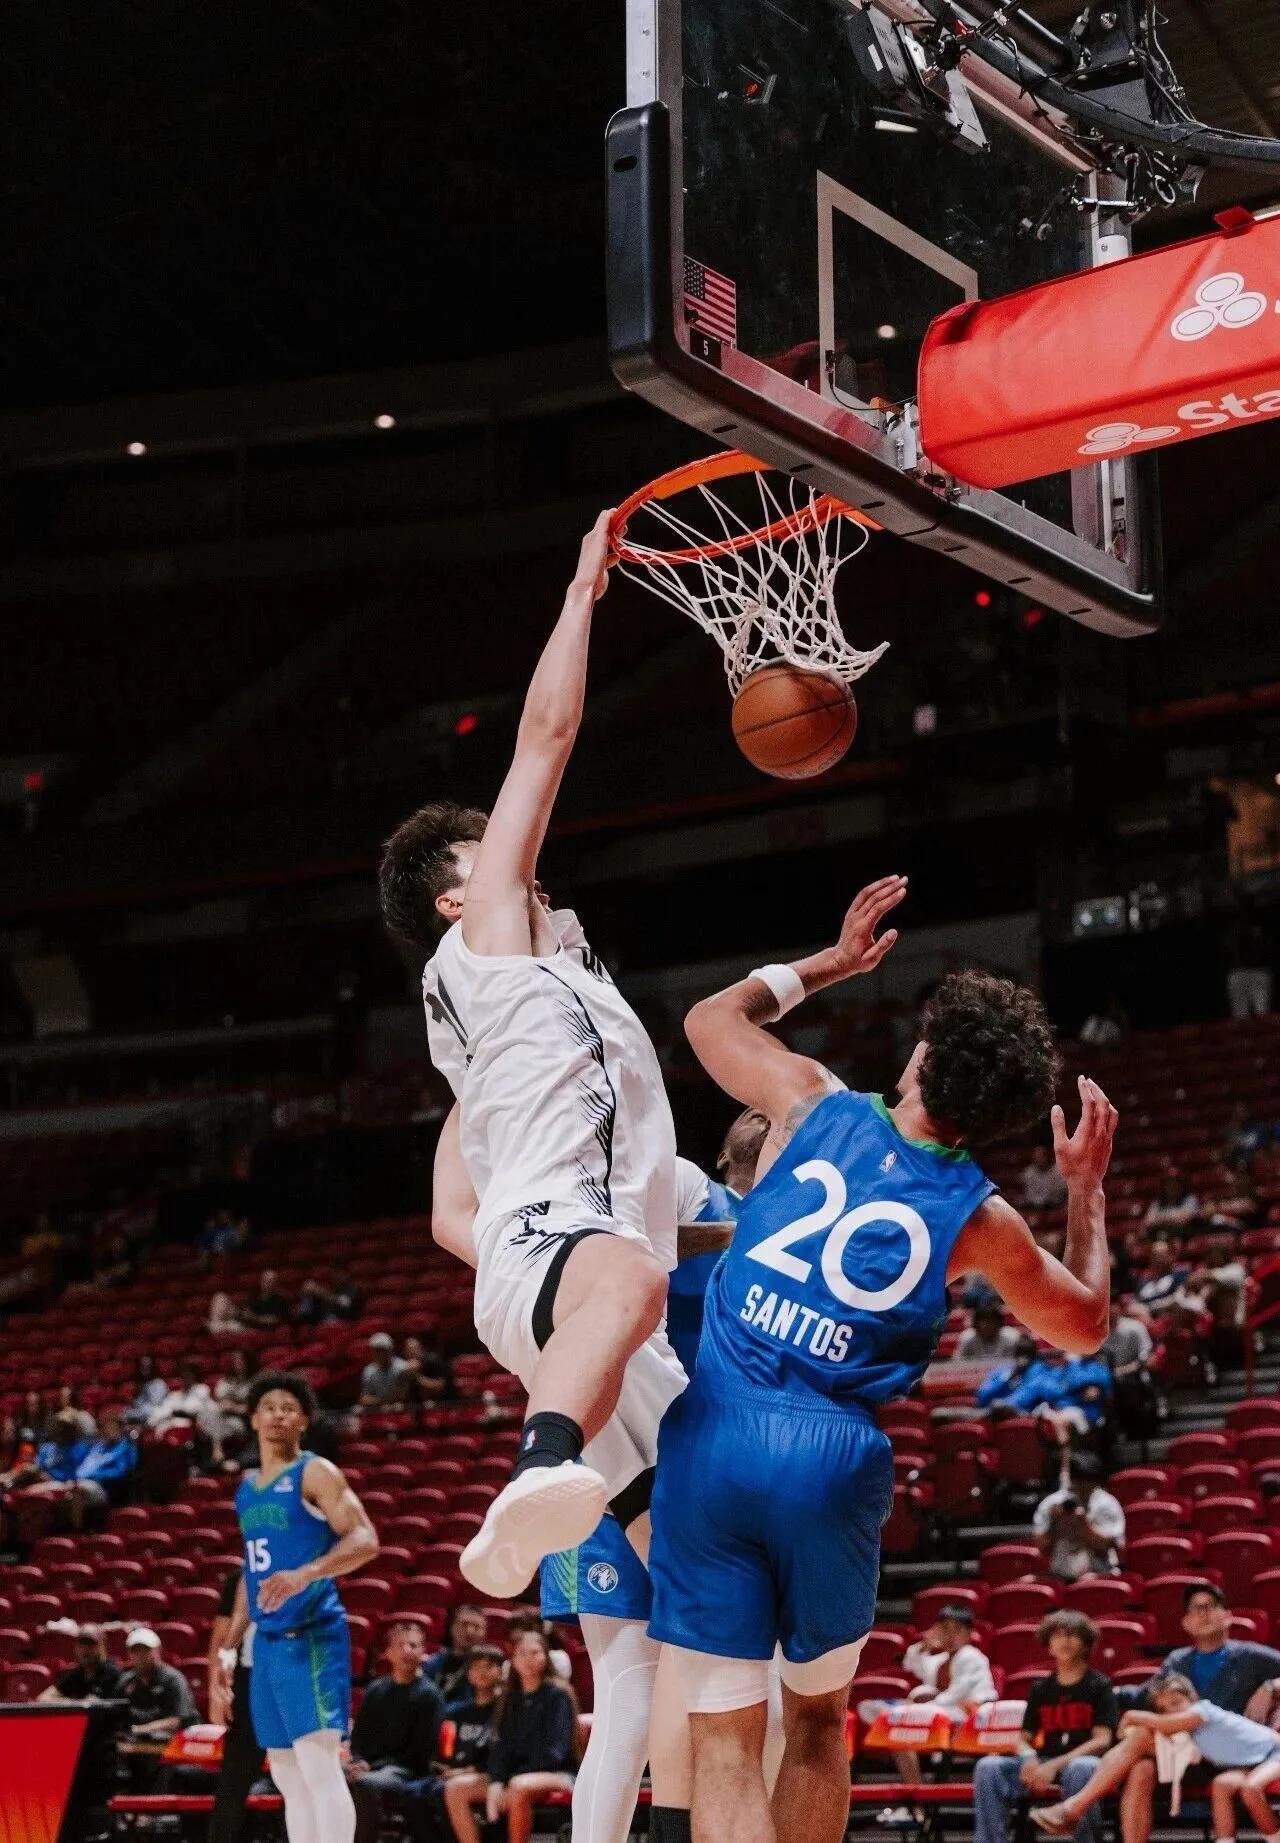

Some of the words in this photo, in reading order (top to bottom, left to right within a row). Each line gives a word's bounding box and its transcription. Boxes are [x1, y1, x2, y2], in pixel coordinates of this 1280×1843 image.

[703, 340, 709, 356] 5
[745, 1159, 931, 1312] 20
[739, 1284, 853, 1362] SANTOS
[246, 1538, 271, 1573] 15
